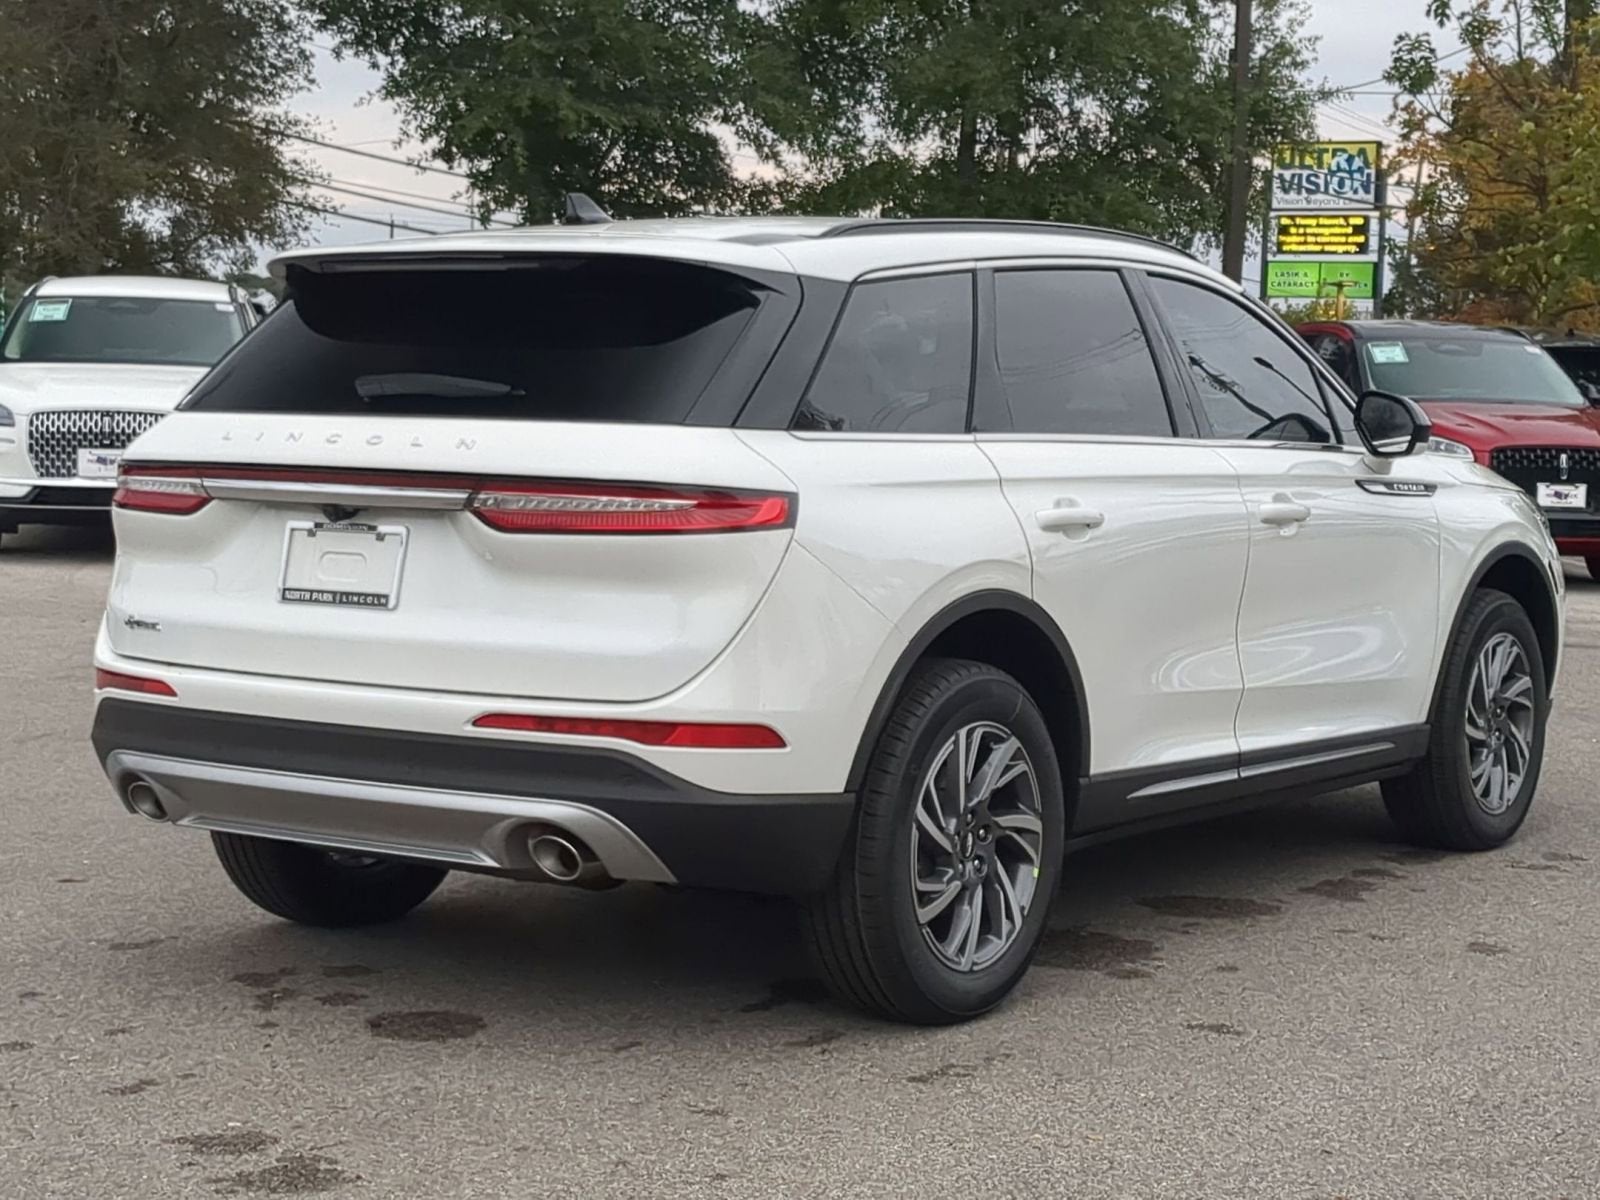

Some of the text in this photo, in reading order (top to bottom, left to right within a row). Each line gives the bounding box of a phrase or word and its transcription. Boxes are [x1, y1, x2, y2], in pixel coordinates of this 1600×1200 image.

[1277, 147, 1371, 170] ULTRA
[1278, 173, 1371, 195] VISION
[1275, 196, 1303, 206] Vision
[1270, 280, 1315, 288] CATARACT
[222, 431, 478, 451] LINCOLN
[284, 590, 335, 602] NORTH PARK
[342, 594, 387, 605] LINCOLN
